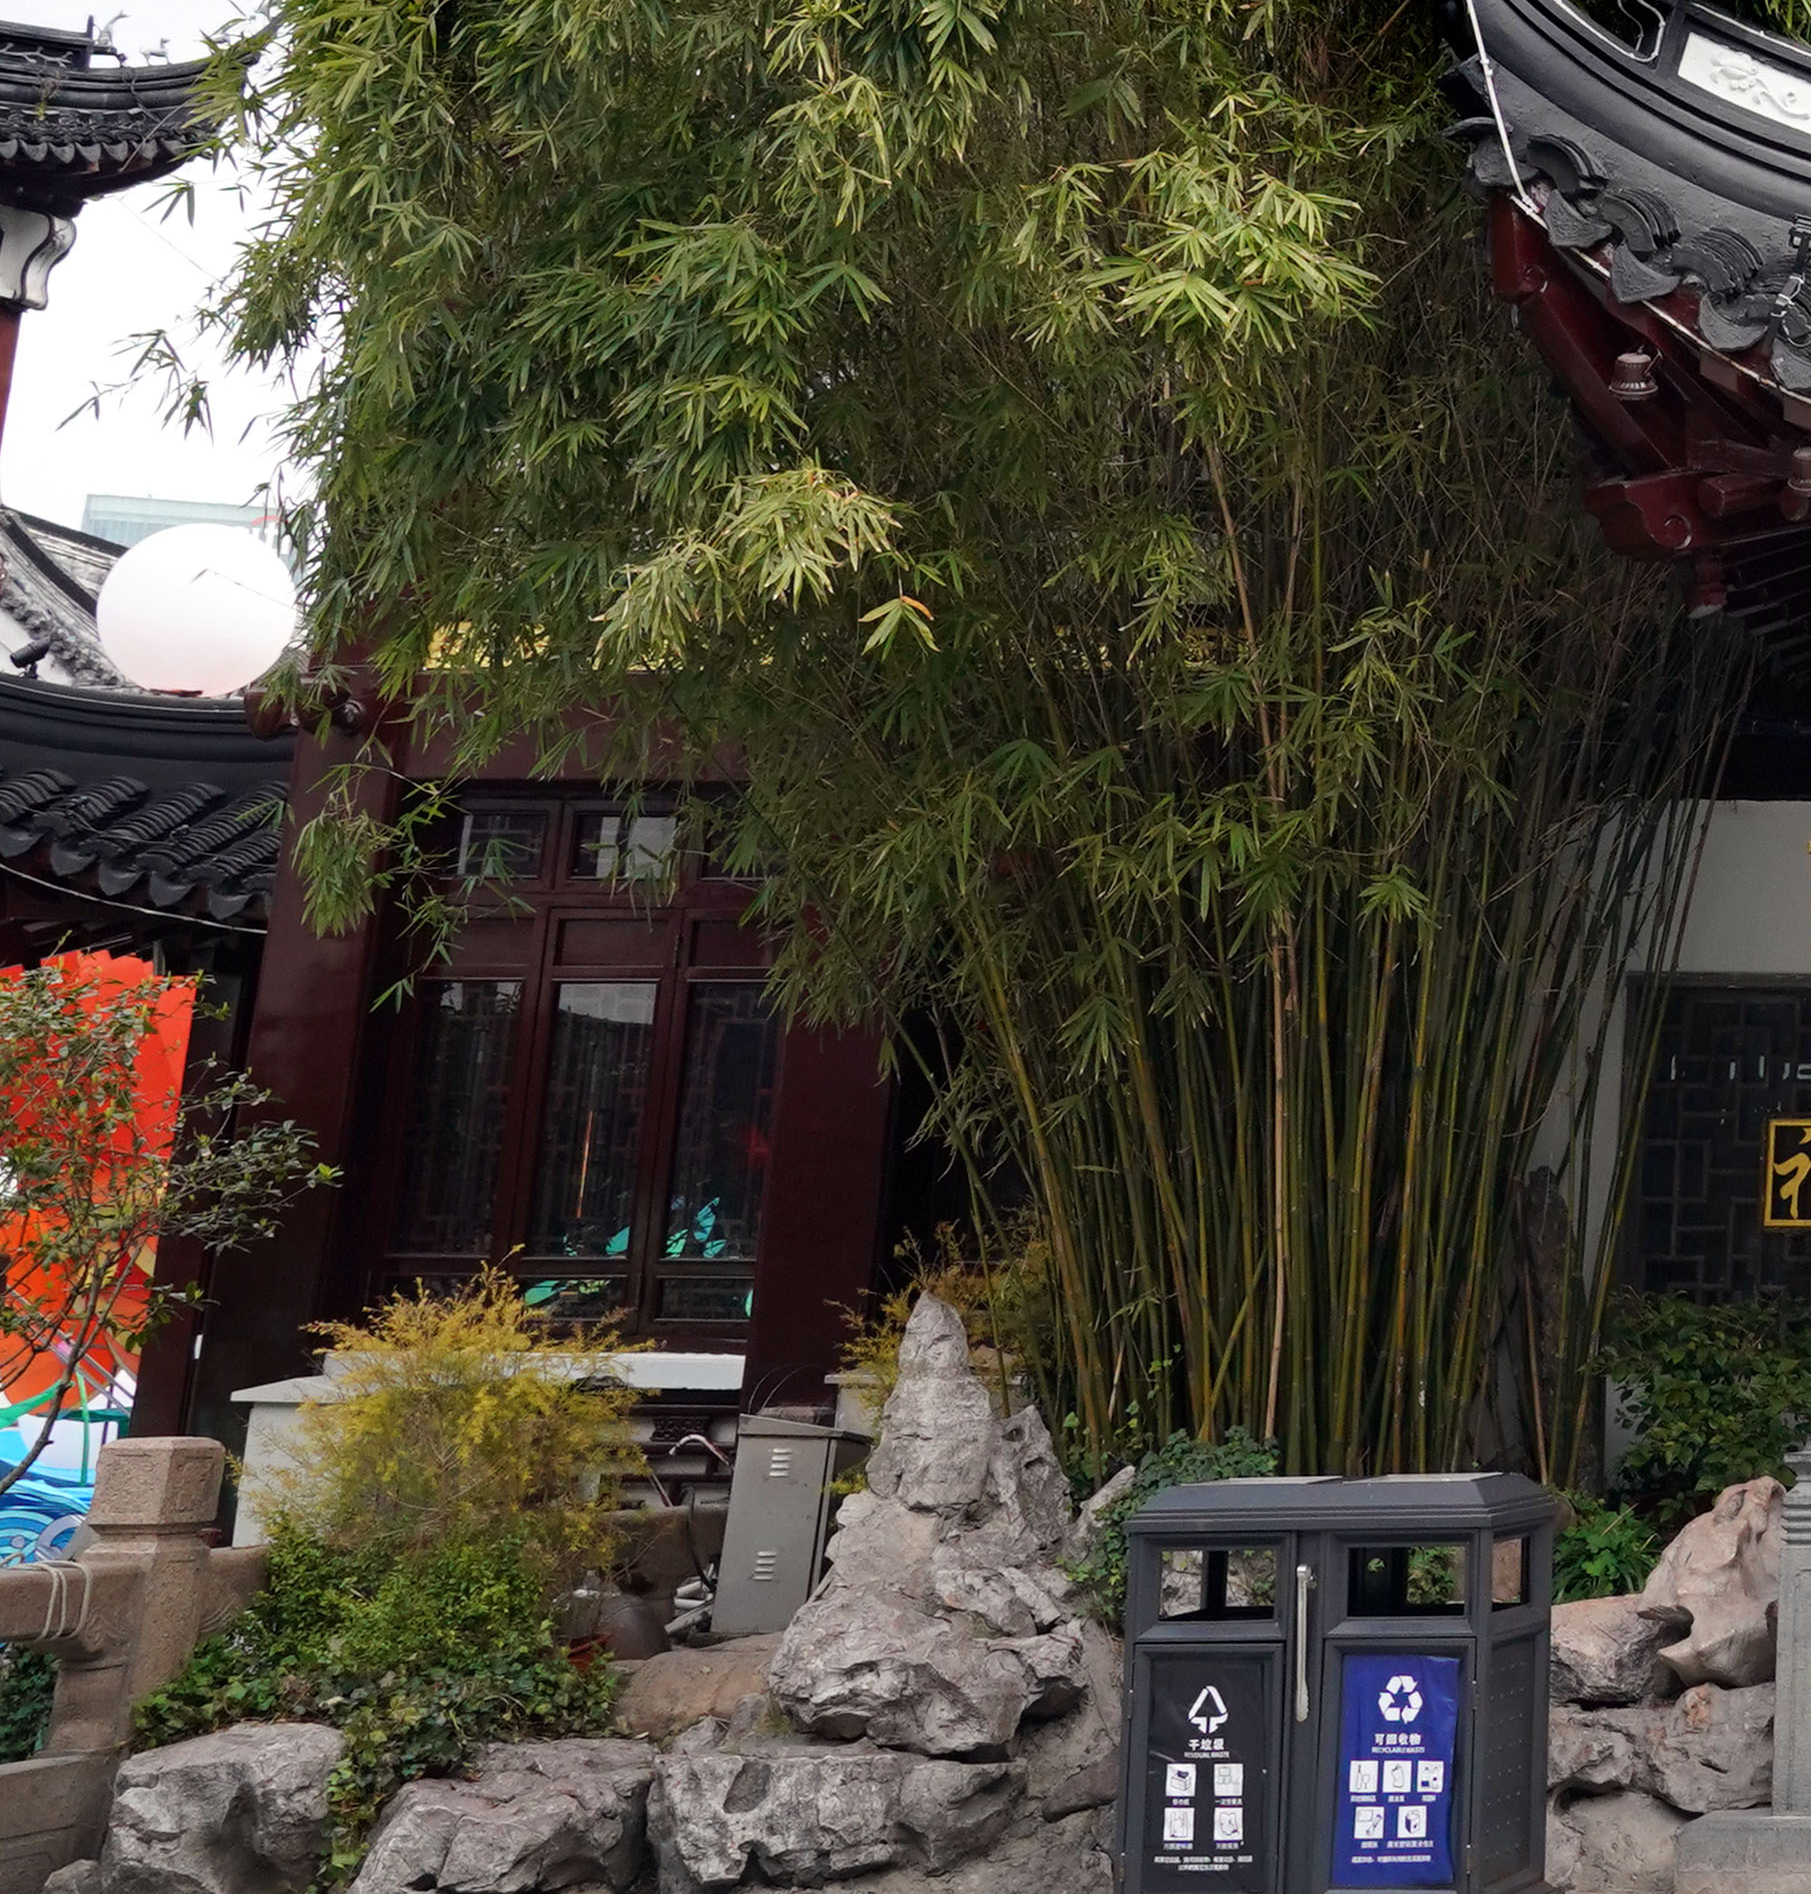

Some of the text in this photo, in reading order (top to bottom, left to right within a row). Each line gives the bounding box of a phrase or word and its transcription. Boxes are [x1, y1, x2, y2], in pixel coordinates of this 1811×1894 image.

[1188, 1738, 1225, 1751] 干垃圾
[1374, 1733, 1422, 1746] 可回收物
